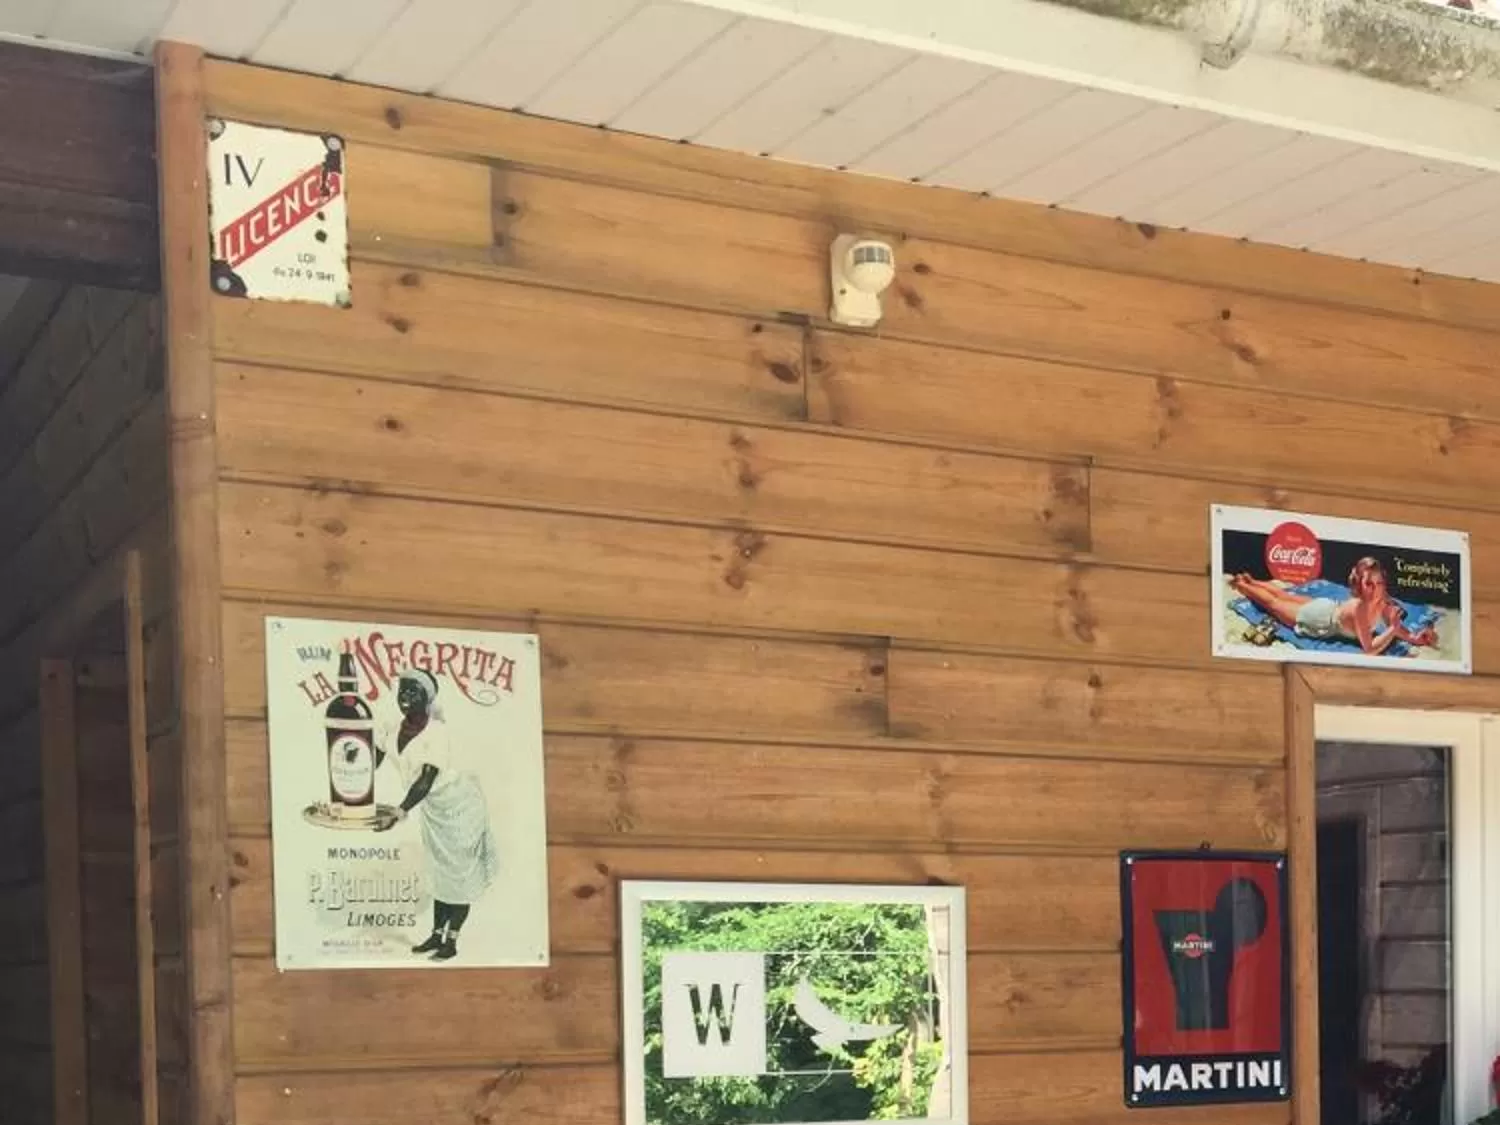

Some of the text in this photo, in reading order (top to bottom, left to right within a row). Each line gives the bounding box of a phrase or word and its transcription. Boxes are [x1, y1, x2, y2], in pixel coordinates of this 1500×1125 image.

[224, 153, 265, 188] IV
[1269, 543, 1317, 567] Coca-Cola
[297, 631, 516, 707] LA NEGRITA
[327, 847, 401, 861] MONOPOLE
[346, 911, 417, 928] LIMOGES
[681, 982, 746, 1047] W
[1133, 1060, 1282, 1093] MARTINI
